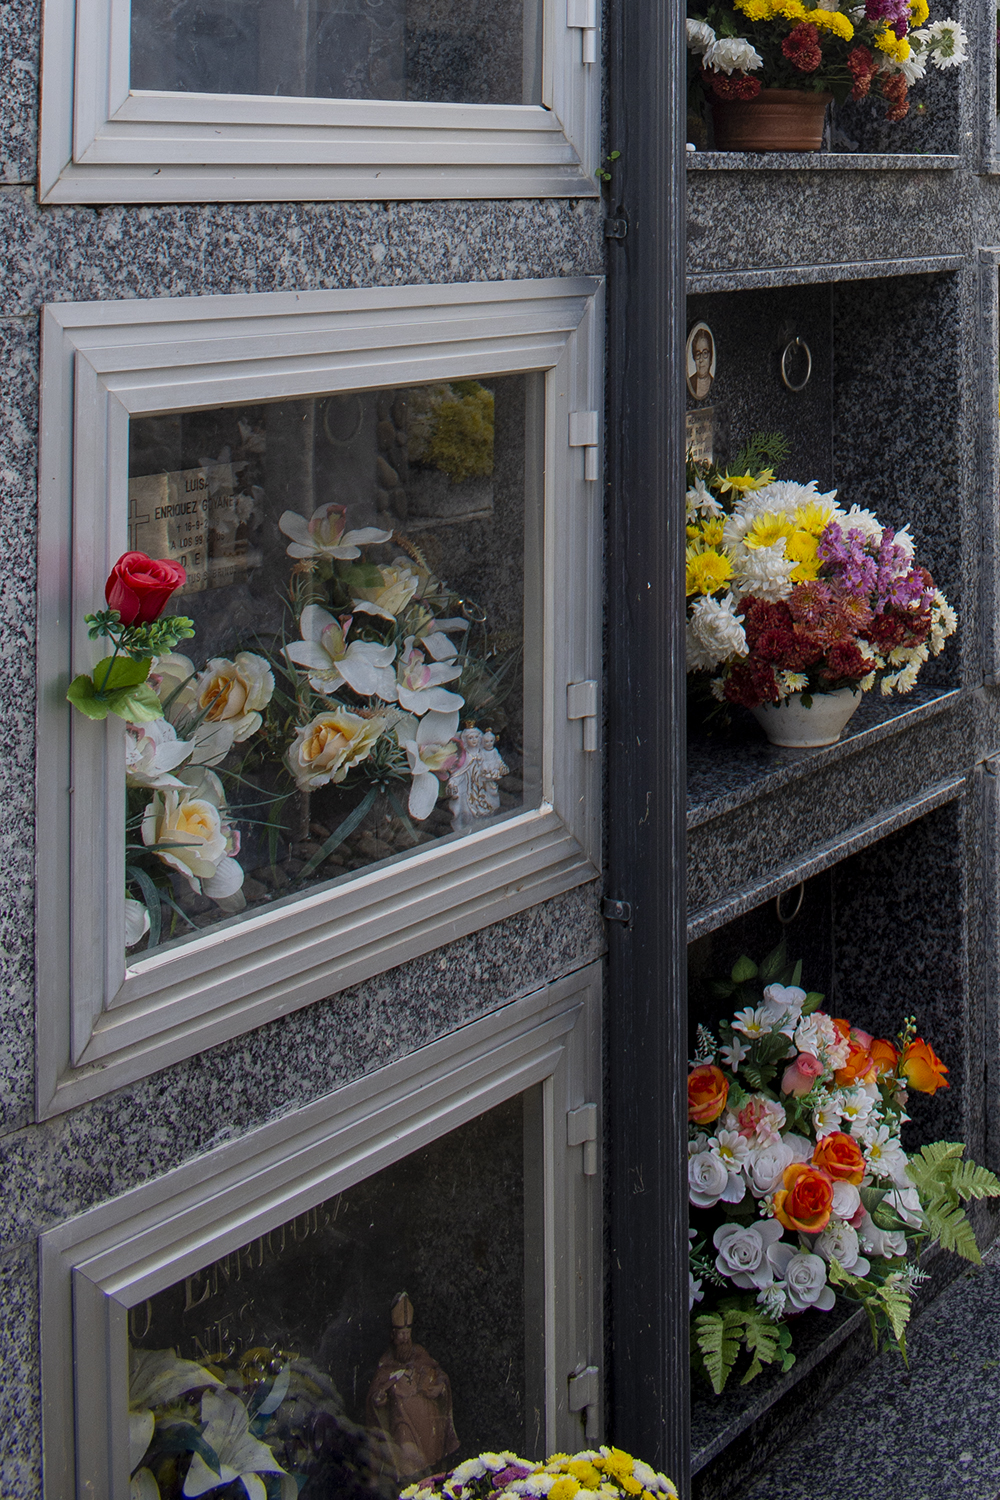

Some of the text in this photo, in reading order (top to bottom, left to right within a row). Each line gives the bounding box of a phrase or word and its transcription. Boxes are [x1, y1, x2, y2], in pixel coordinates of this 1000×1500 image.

[185, 477, 210, 493] LUISA
[154, 501, 198, 520] ENRIQUEZ
[170, 541, 177, 550] A
[180, 536, 193, 549] LOS
[194, 534, 203, 545] 99
[203, 565, 238, 581] SBRINOS
